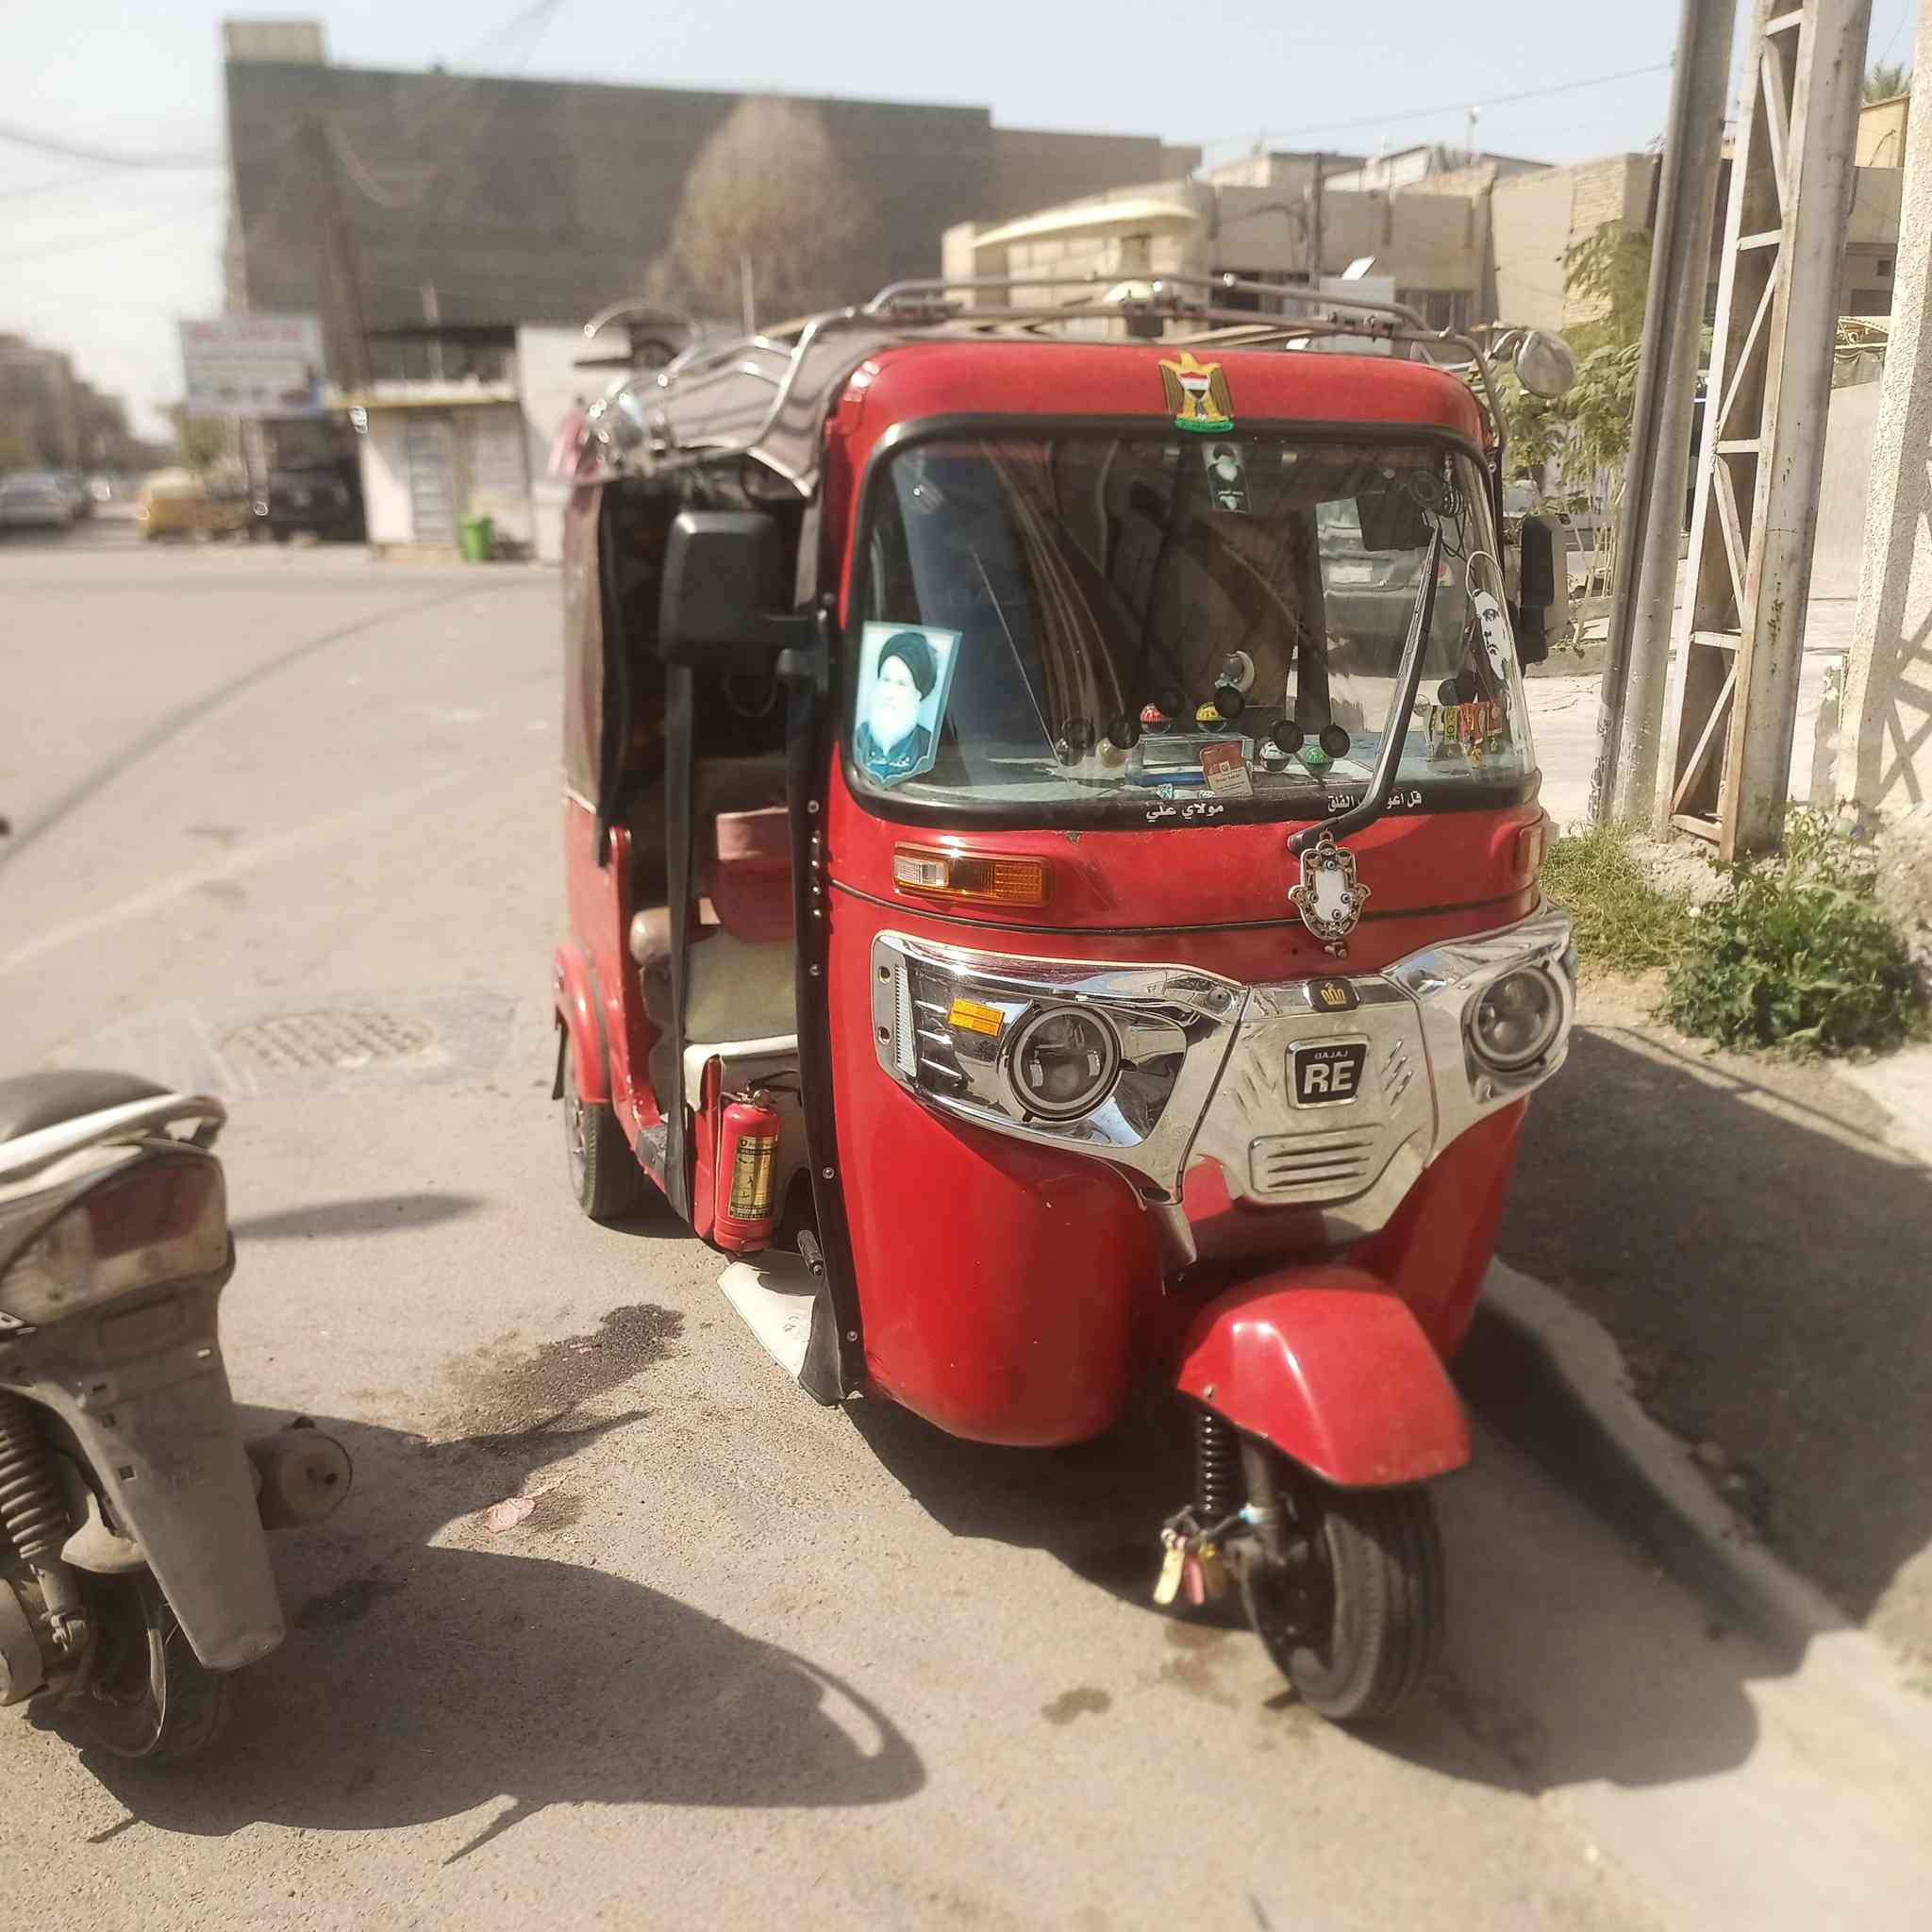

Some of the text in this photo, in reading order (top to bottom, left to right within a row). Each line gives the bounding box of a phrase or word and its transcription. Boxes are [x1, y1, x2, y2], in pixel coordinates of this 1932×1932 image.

[1327, 794, 1356, 812] الفلق
[1407, 791, 1422, 808] قل
[1145, 802, 1224, 823] مولاي علي
[1303, 1059, 1356, 1094] RE
